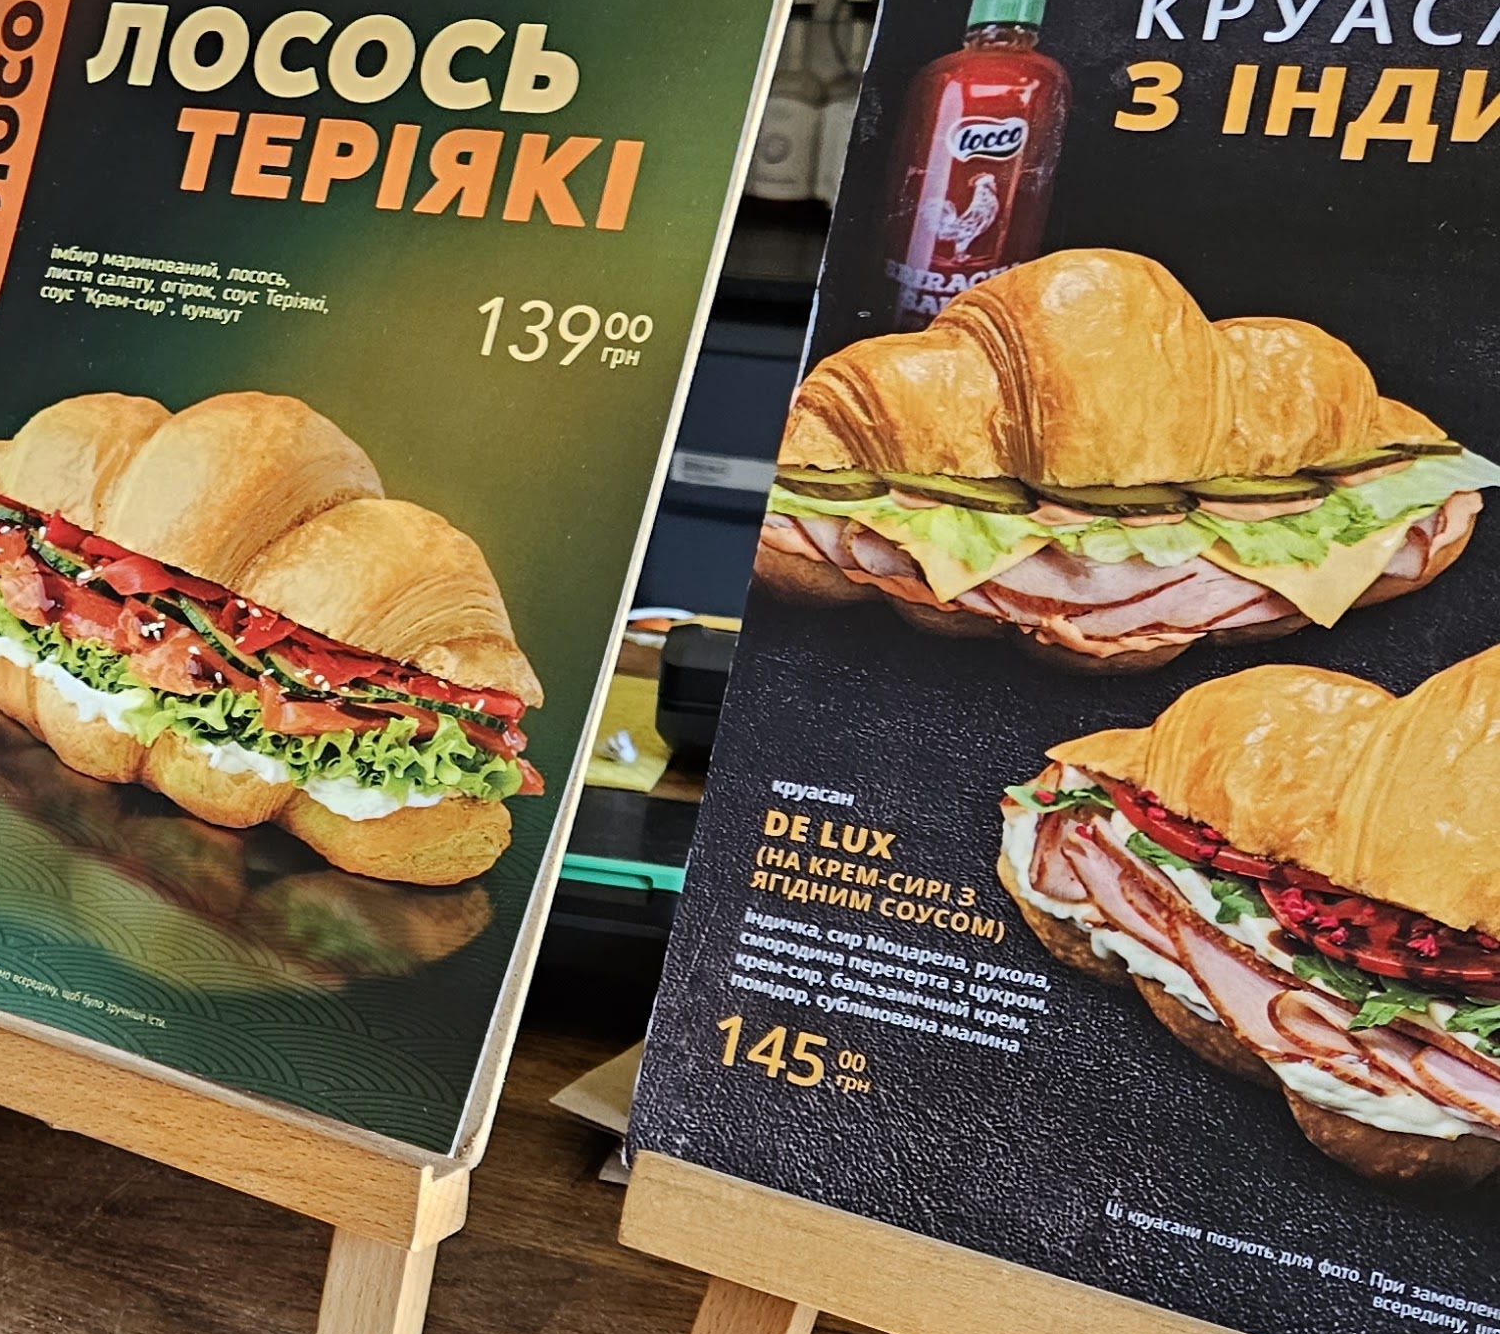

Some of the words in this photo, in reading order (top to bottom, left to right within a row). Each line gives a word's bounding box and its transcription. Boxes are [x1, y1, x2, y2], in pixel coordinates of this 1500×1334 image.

[85, 1, 580, 115] ЛОСОСЬ
[1114, 60, 1184, 133] З
[176, 106, 646, 233] ТЕРІЯКІ
[959, 126, 1022, 151] tocco
[44, 266, 93, 284] листя
[160, 278, 218, 301] огірок,
[222, 288, 260, 306] соус
[266, 288, 330, 315] Теріякі,
[50, 243, 99, 267] імбир
[102, 252, 222, 282] маринований,
[226, 266, 291, 289] лосось,
[39, 284, 76, 304] соус
[181, 302, 244, 325] кунжут
[477, 296, 601, 366] 139
[604, 311, 654, 344] 00
[600, 346, 641, 369] грн
[772, 779, 855, 808] круасан
[764, 809, 811, 844] DE
[820, 821, 896, 860] LUX
[750, 868, 873, 913] ЯГІДНИМ
[879, 896, 1006, 945] СОУСОМ)
[755, 845, 801, 872] (НА
[809, 855, 951, 901] КРЕМ-СИРІ
[958, 886, 977, 908] З
[739, 930, 845, 967] смородина
[848, 953, 949, 994] перетерта
[952, 976, 965, 994] з
[968, 979, 1050, 1016] цукром,
[744, 907, 823, 940] індичка,
[827, 928, 861, 951] сир
[865, 934, 971, 974] Моцарела,
[975, 961, 1052, 992] рукола,
[730, 971, 813, 1006] помідор,
[815, 994, 947, 1035] сублімована
[942, 1022, 1021, 1054] малина
[735, 951, 826, 987] крем-сир,
[830, 972, 971, 1017] бальзамічний
[973, 1006, 1031, 1035] крем,
[716, 1014, 828, 1088] 145
[835, 1073, 872, 1094] грн
[838, 1049, 867, 1074] 00
[1105, 1201, 1125, 1220] Ці
[1127, 1209, 1202, 1240] круасани
[1206, 1227, 1275, 1261] позують
[1278, 1249, 1313, 1271] для
[1369, 1271, 1406, 1294] При
